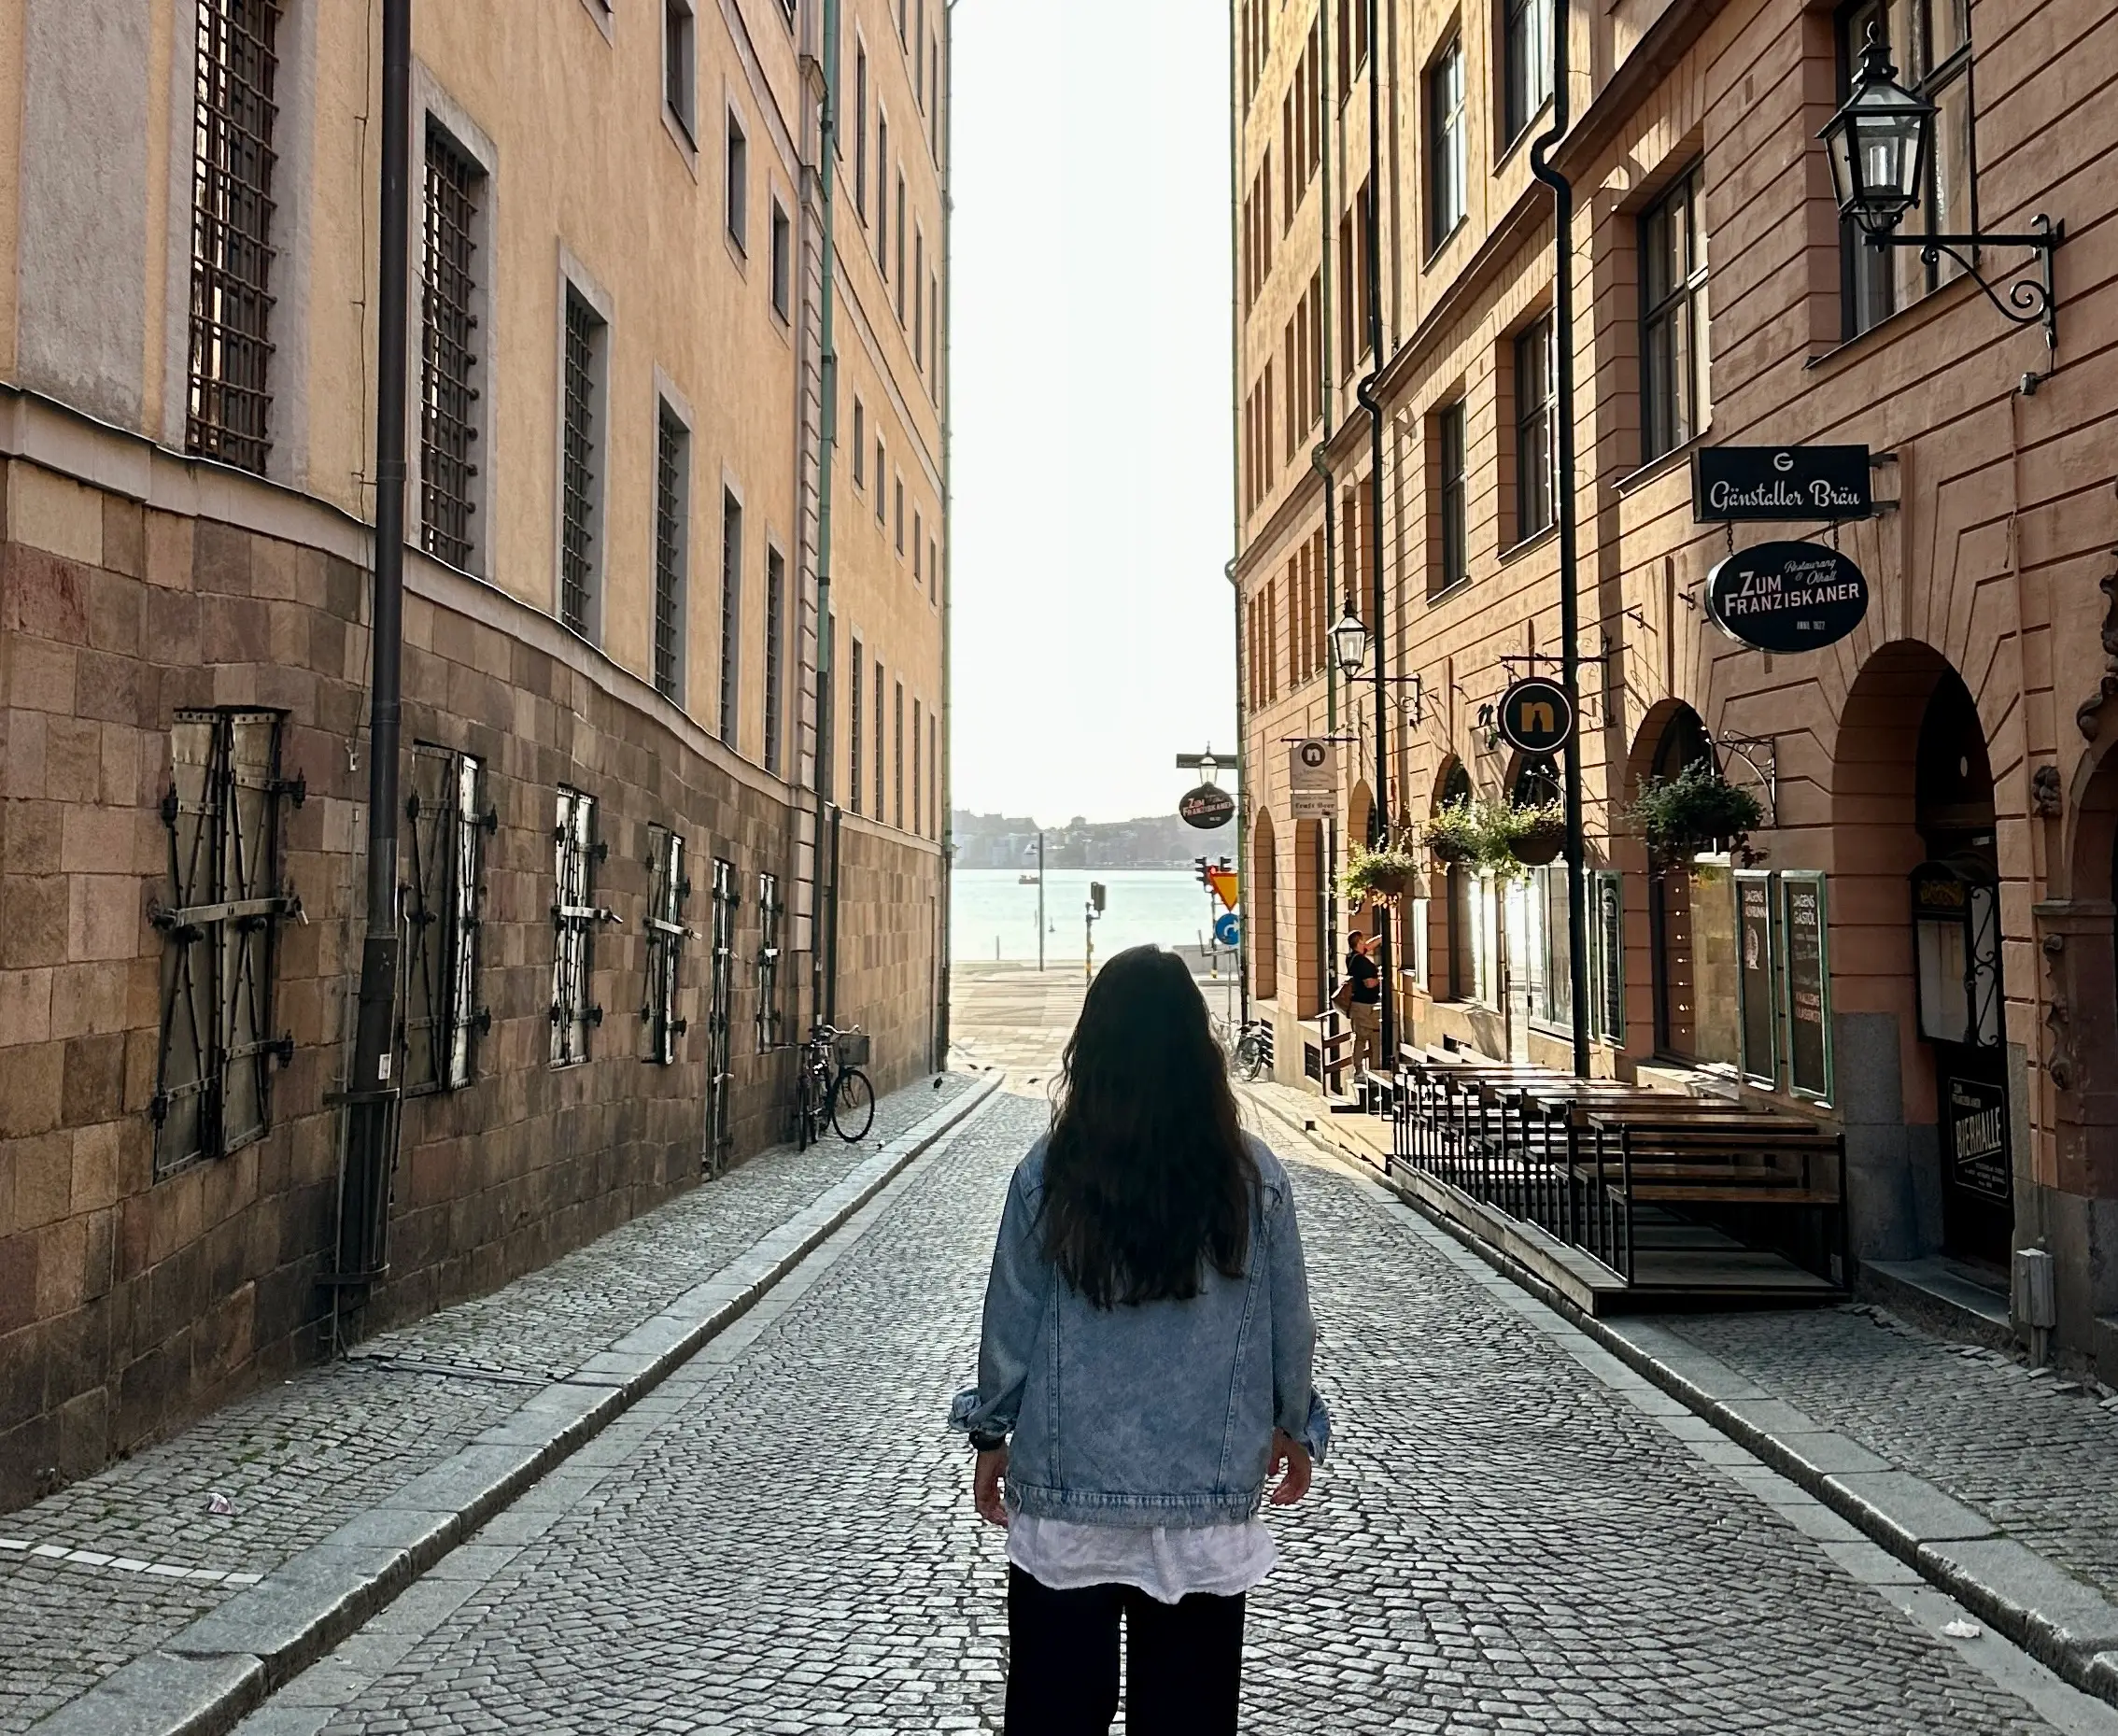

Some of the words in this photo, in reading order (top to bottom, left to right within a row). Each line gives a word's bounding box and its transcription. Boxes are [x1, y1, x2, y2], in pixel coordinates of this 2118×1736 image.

[1773, 452, 1794, 472] G
[1710, 480, 1804, 512] Gänstaller
[1809, 479, 1861, 507] Bräu
[1724, 583, 1860, 616] FRANZISKANER
[1739, 571, 1782, 598] ZUM
[1956, 1106, 2002, 1159] BIERHALLE
